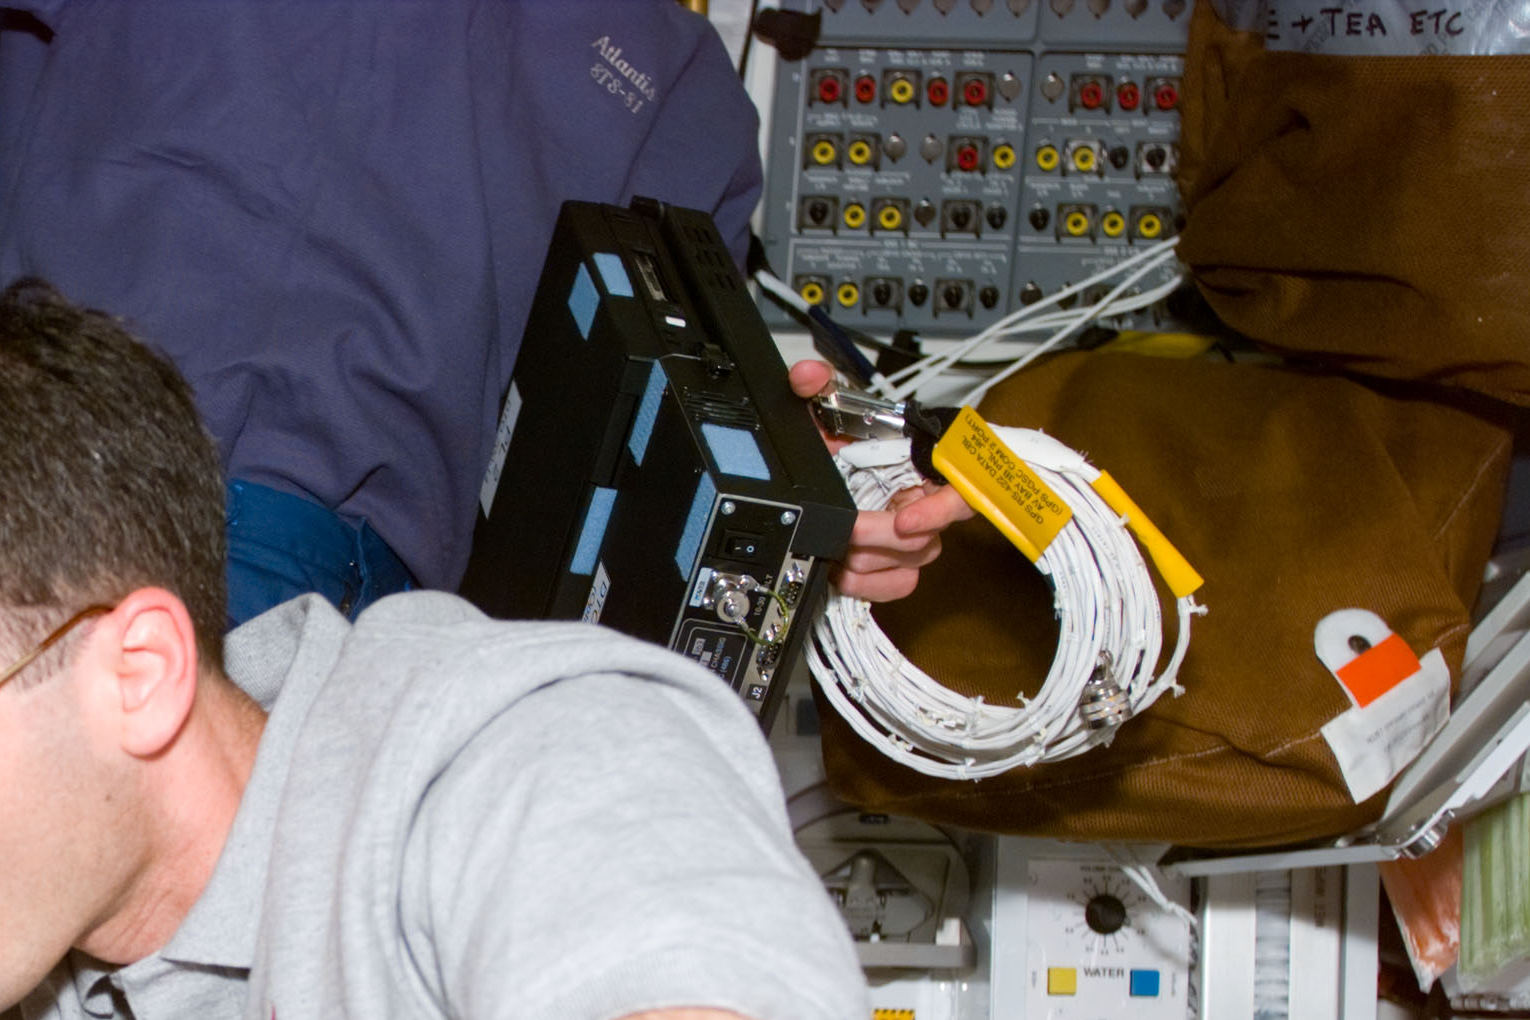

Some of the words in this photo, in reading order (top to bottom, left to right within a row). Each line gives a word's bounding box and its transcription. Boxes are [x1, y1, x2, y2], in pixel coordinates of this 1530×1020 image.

[1320, 8, 1387, 36] TEA
[1409, 8, 1464, 36] ETC
[590, 36, 656, 101] Atlantis
[977, 453, 997, 477] DATA
[995, 448, 1015, 470] COM
[1025, 504, 1043, 524] GPS
[752, 687, 763, 699] J2
[1084, 967, 1124, 979] WATER
